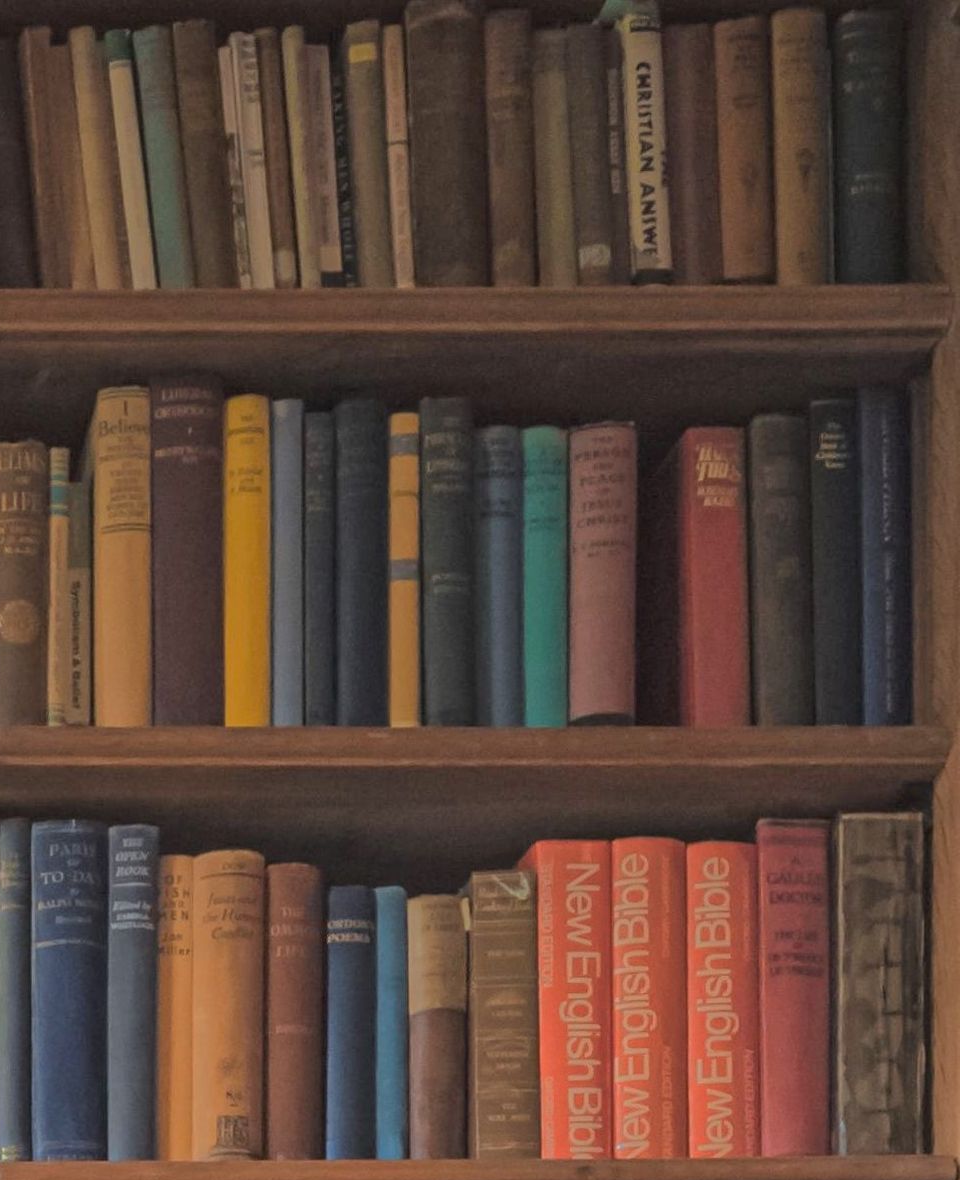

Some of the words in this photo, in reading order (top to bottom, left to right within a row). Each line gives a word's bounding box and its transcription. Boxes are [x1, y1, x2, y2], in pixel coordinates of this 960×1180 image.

[636, 62, 654, 172] CHRISTIAN
[565, 862, 600, 946] New
[616, 852, 651, 945] Bible
[695, 856, 731, 949] Bible
[559, 951, 602, 1081] English
[616, 950, 658, 1081] English
[696, 953, 739, 1084] English
[567, 1087, 604, 1160] Bibl
